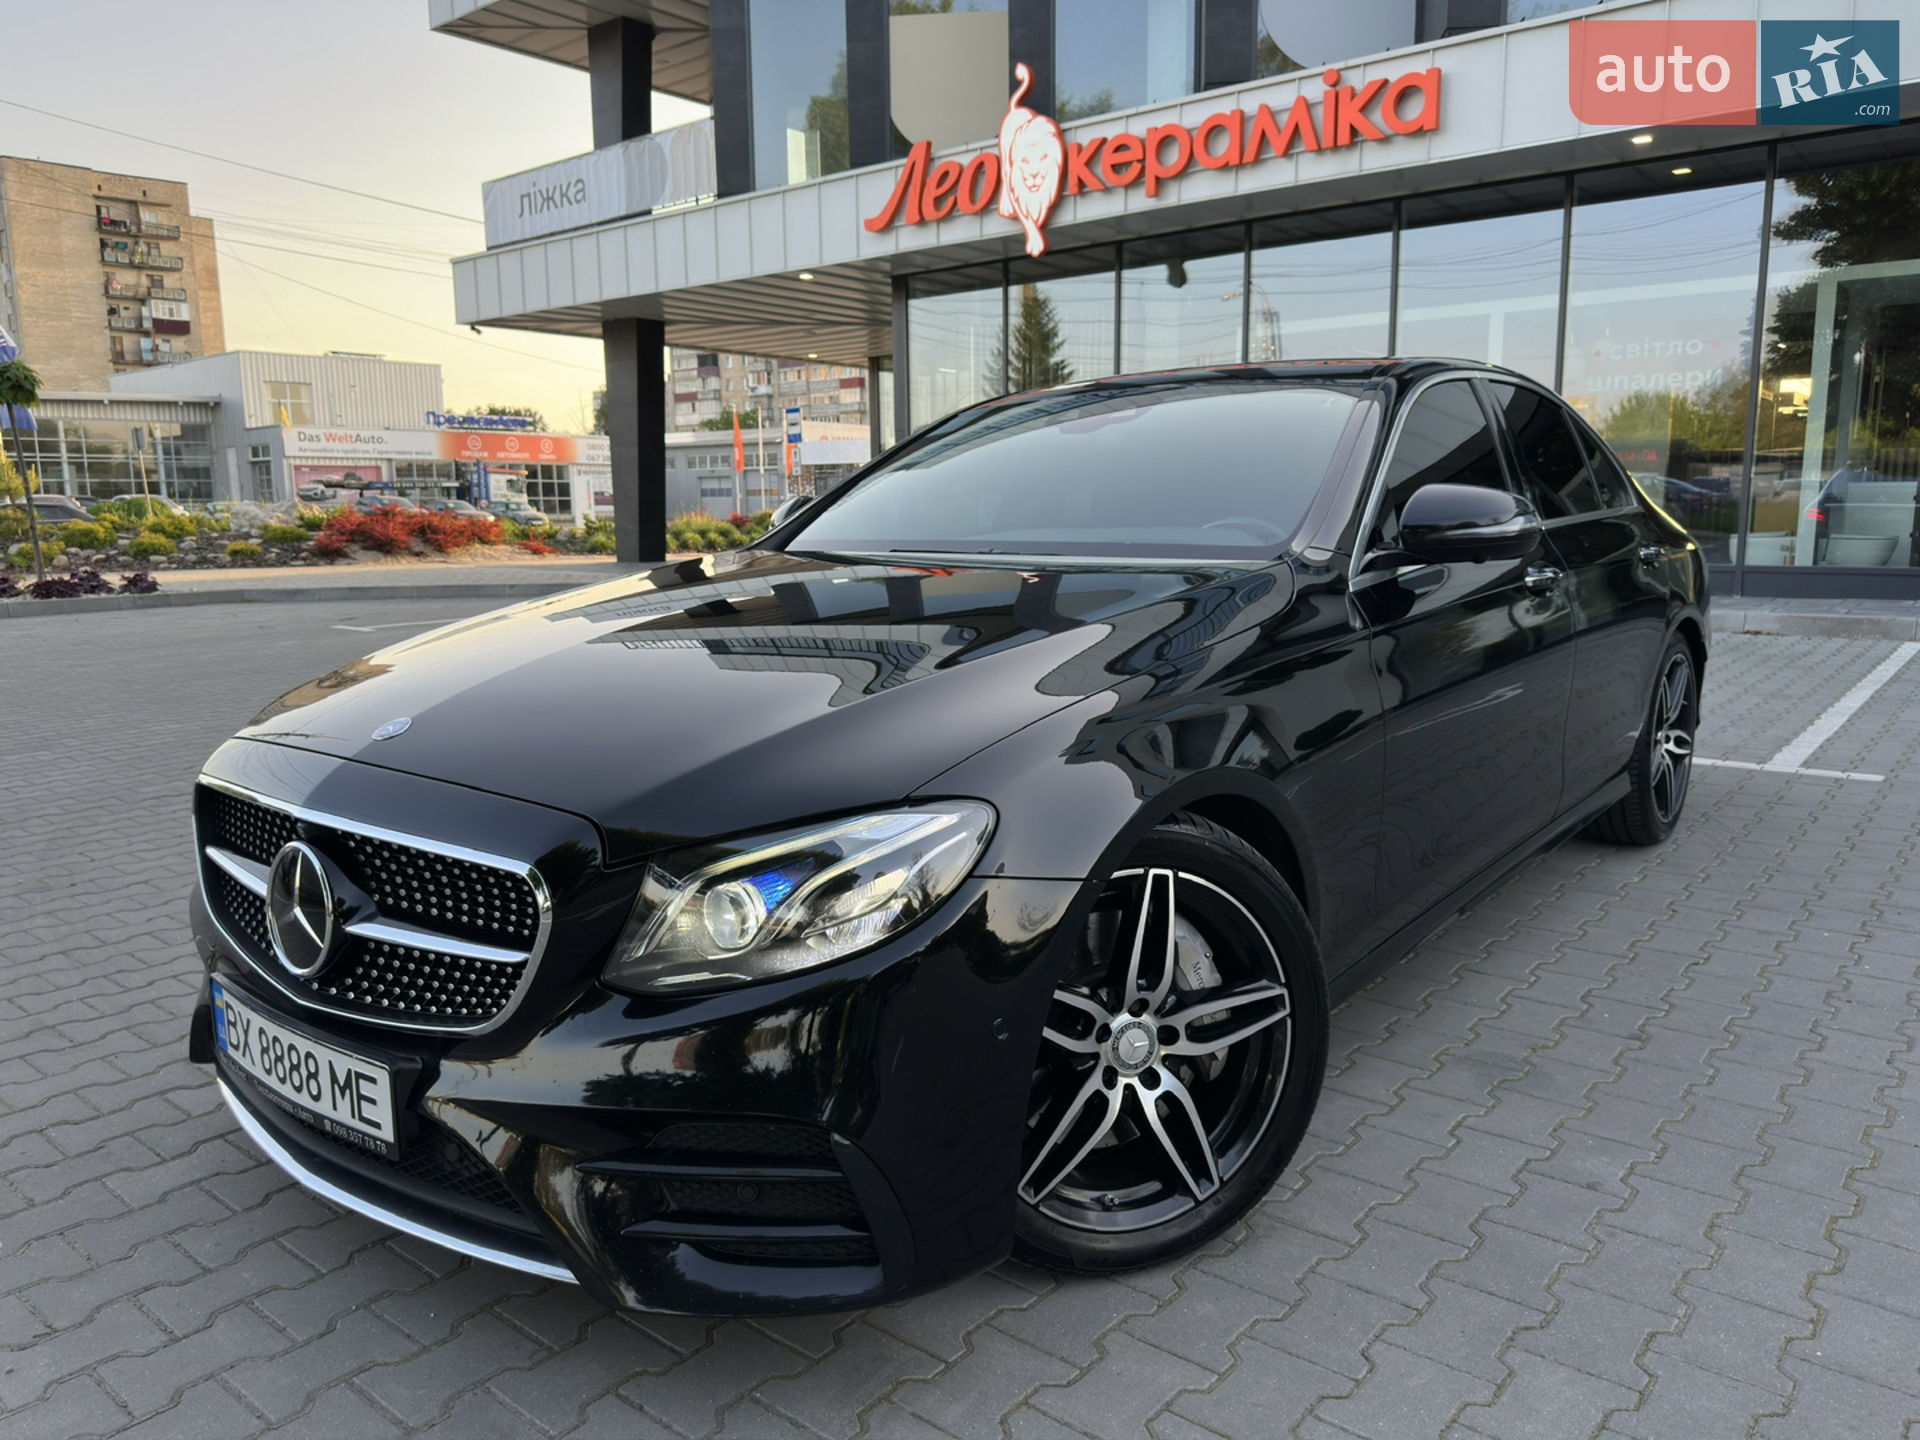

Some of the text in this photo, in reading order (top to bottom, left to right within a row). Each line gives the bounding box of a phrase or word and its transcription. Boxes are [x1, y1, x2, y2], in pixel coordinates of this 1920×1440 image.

[864, 67, 1441, 233] Лео кераміка
[519, 178, 586, 218] ліжка
[1610, 338, 1703, 360] світло
[1587, 368, 1724, 395] шпалери
[298, 431, 388, 445] Das WeltAuto.
[258, 1026, 322, 1102] 8888
[328, 1059, 382, 1131] ME
